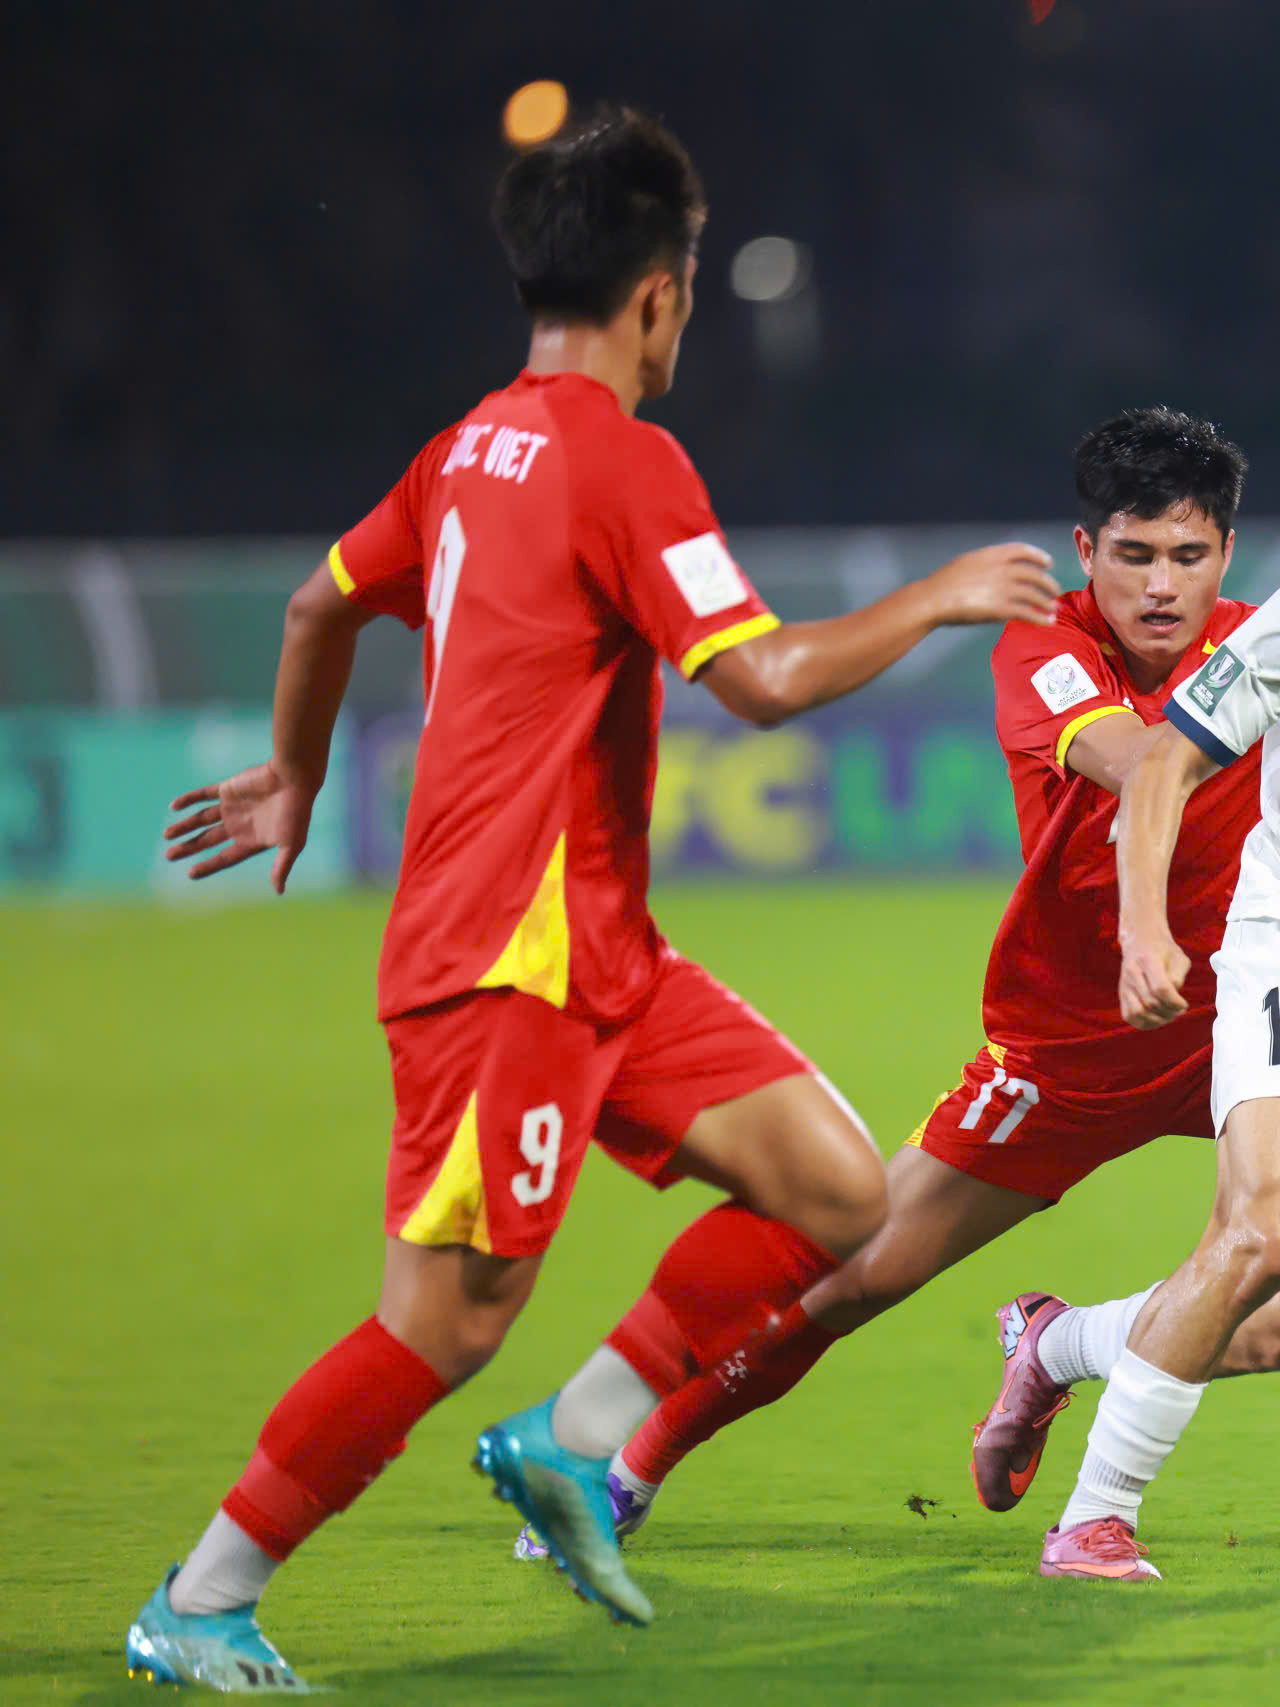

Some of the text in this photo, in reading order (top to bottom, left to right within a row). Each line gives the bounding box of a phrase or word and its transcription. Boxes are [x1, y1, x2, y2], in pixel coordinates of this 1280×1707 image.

[483, 425, 549, 484] VIET
[957, 1066, 1040, 1144] 17
[511, 1101, 564, 1208] 9
